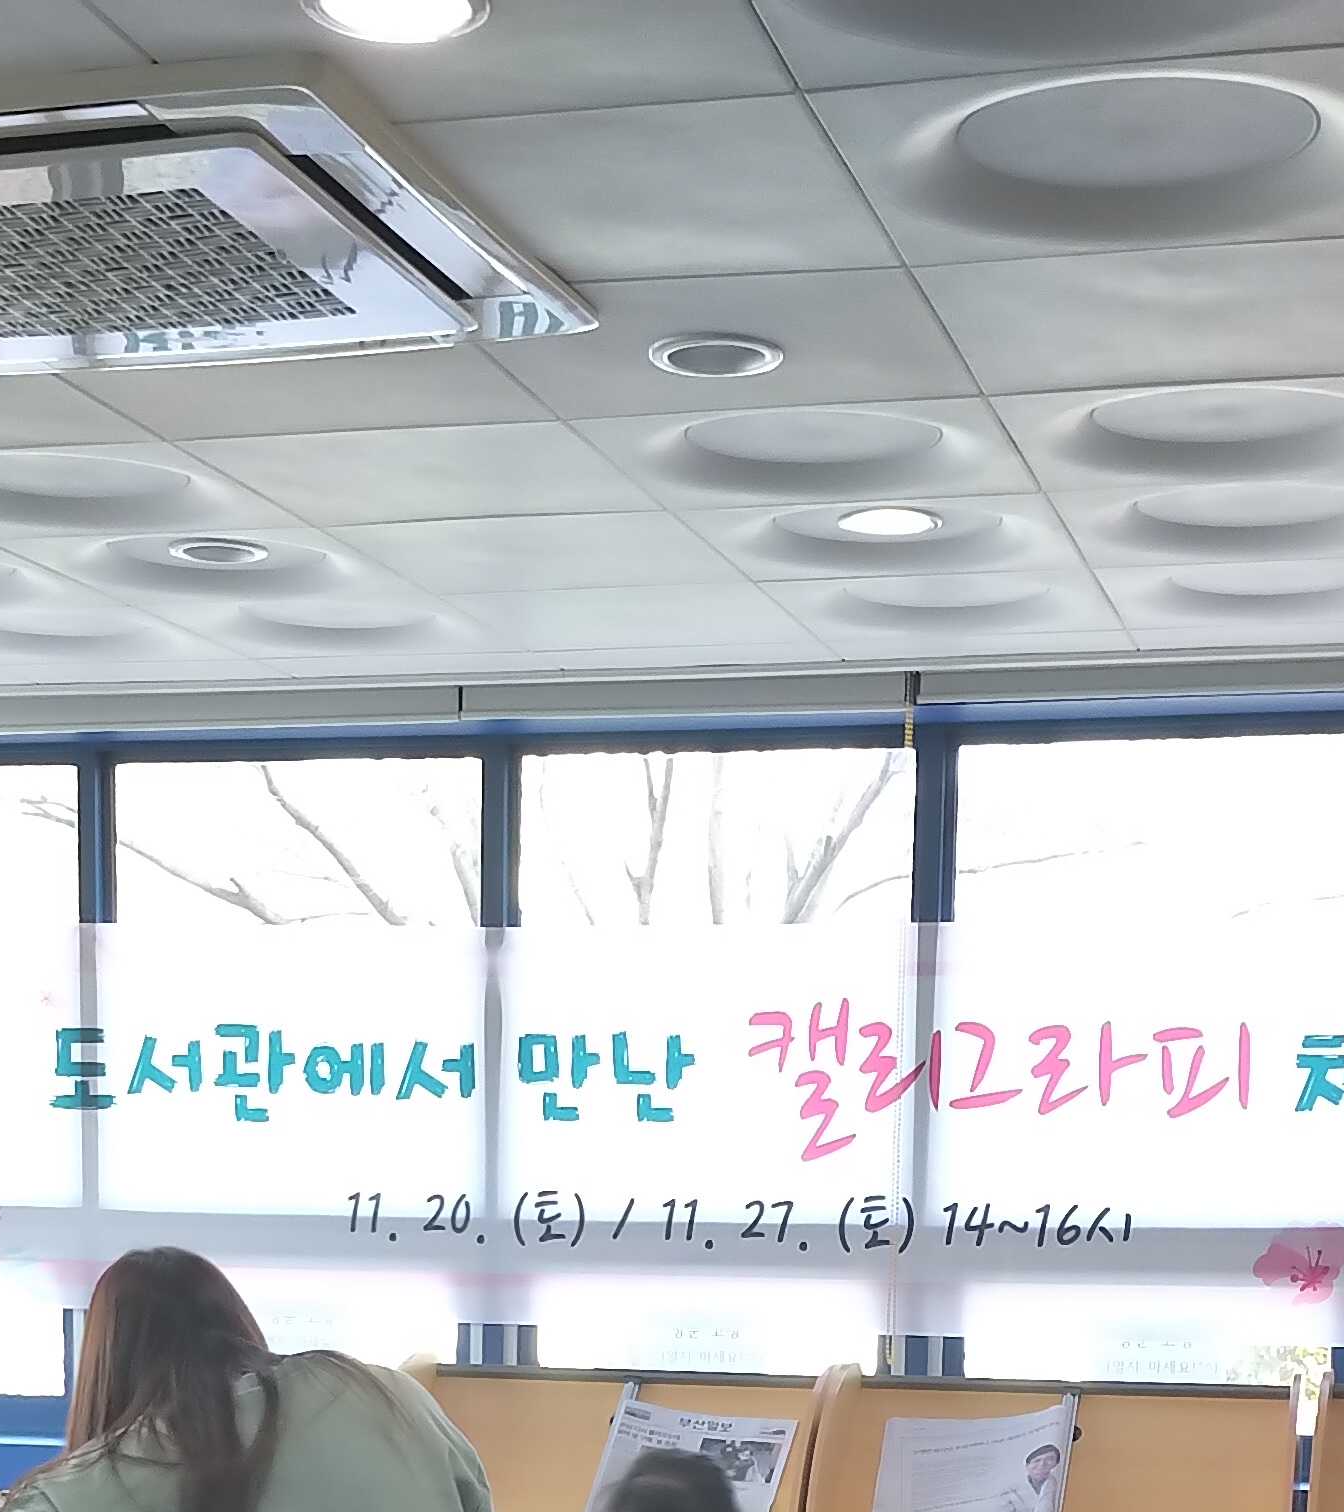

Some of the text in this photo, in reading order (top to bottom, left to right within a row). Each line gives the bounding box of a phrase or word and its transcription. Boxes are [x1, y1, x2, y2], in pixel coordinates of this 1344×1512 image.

[48, 1022, 477, 1123] 도서관에서
[517, 1029, 696, 1123] 만난
[747, 998, 1251, 1163] 캘리그라피
[347, 1190, 1133, 1256] 11. 20. (토) / 11. 27. (토) 14~16시
